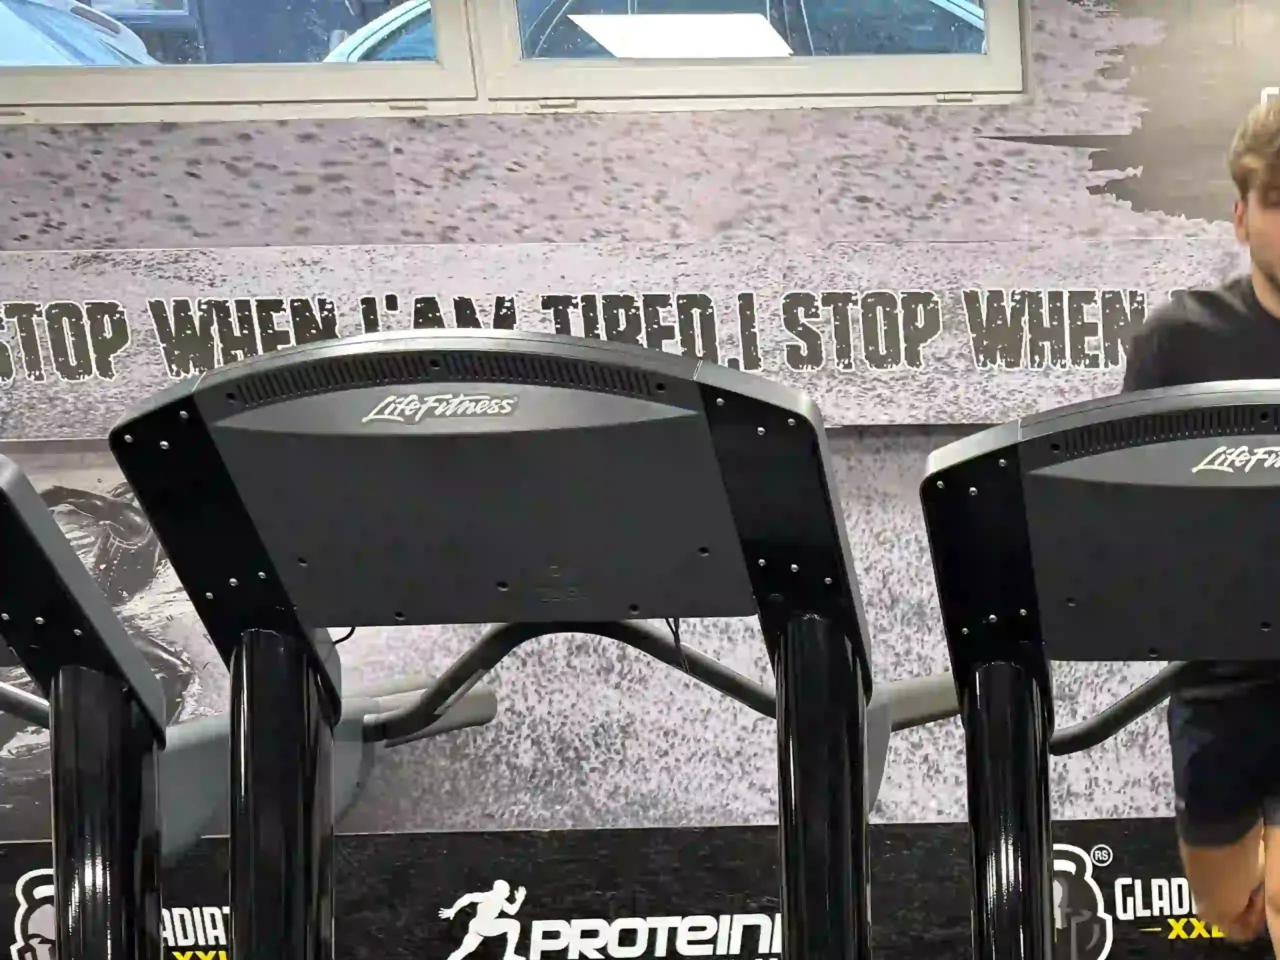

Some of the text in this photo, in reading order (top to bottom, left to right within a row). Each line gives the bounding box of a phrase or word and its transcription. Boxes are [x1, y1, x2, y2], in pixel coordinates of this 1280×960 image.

[147, 297, 342, 380] WHEN
[781, 289, 943, 372] STOP
[961, 288, 1148, 370] WHEN
